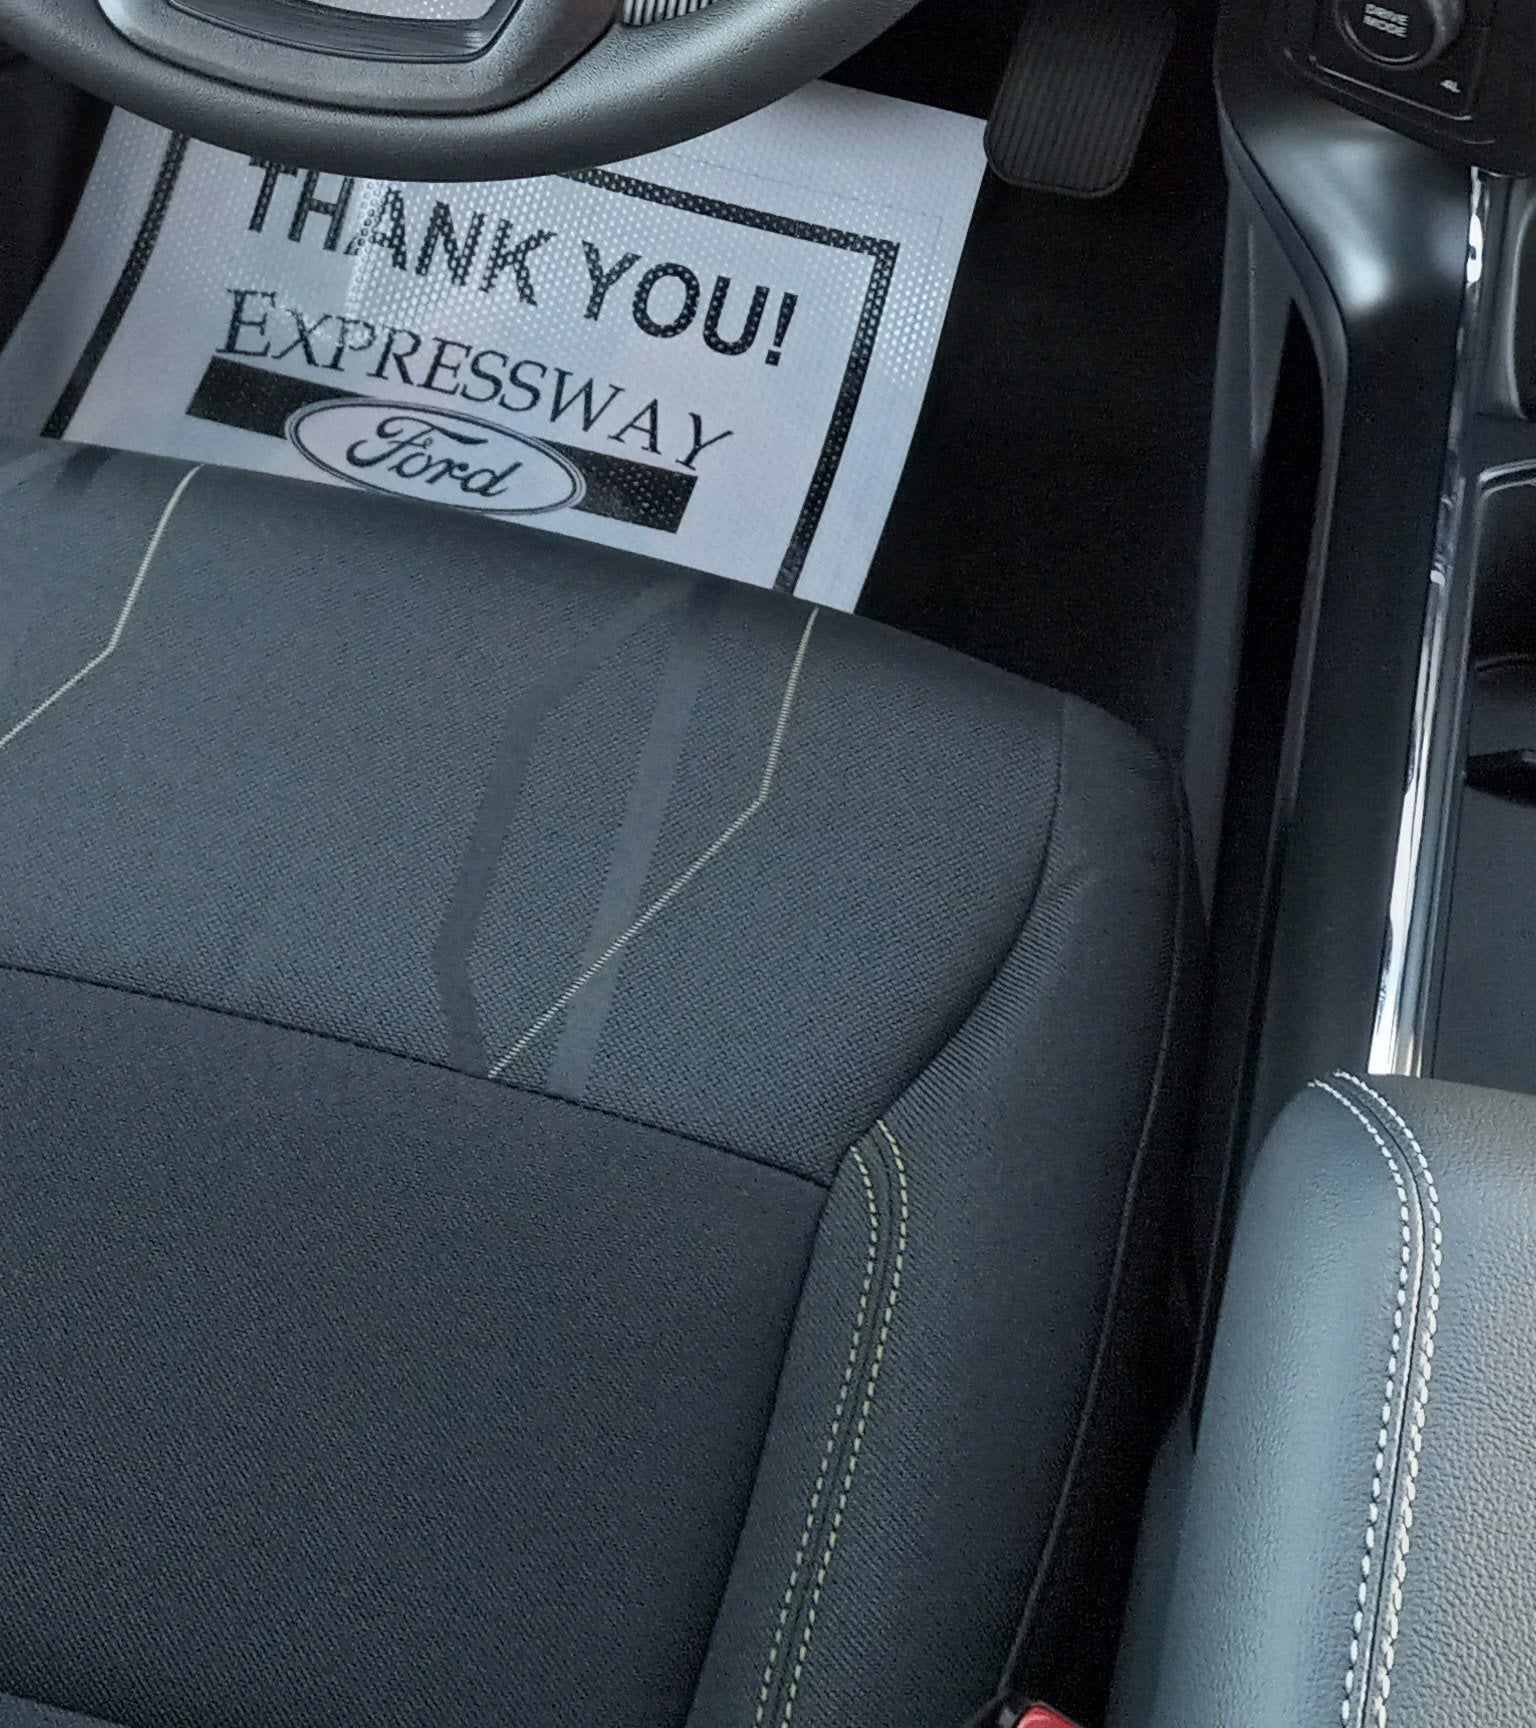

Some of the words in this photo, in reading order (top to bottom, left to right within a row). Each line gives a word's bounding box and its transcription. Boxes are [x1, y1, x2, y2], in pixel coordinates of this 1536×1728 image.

[249, 155, 557, 307] THANK
[582, 239, 798, 367] YOU!
[216, 288, 734, 472] EXPRESSWAY
[347, 415, 524, 499] Ford
